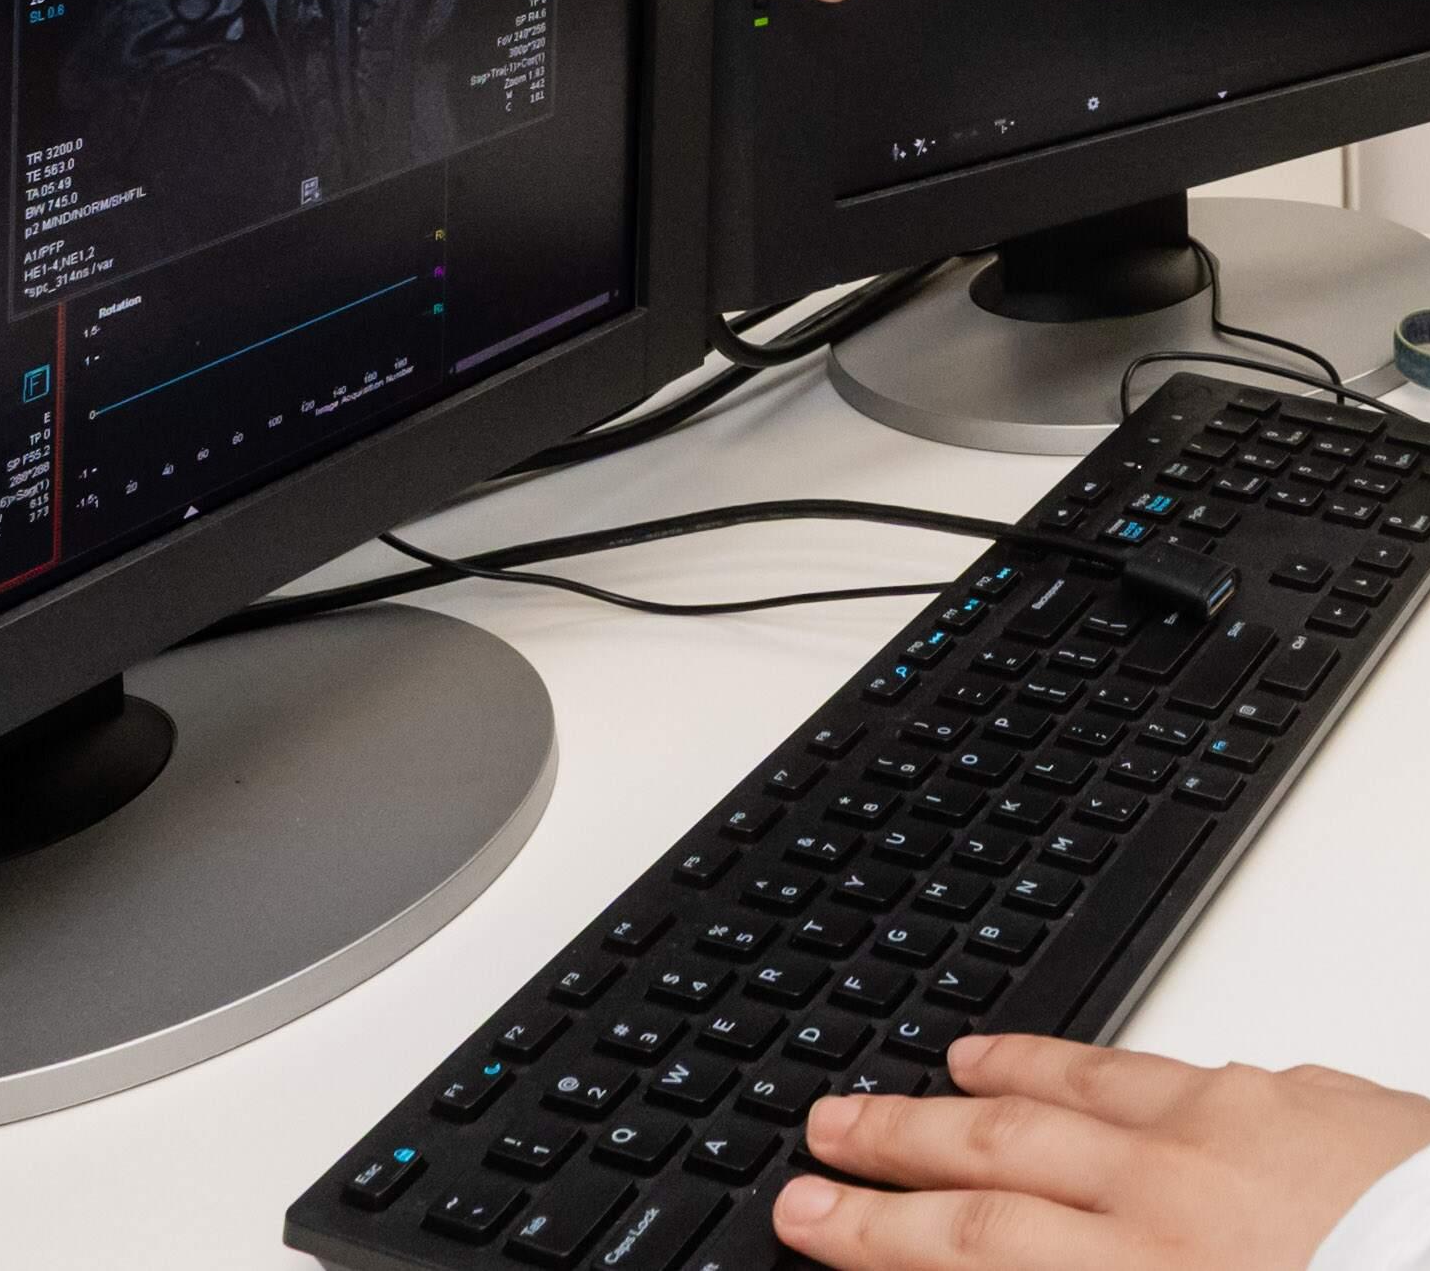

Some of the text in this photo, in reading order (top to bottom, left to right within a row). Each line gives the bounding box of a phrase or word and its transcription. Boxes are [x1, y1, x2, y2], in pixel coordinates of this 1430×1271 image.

[26, 138, 83, 165] TR 3200.0
[26, 158, 74, 184] TE 563.0
[41, 176, 72, 197] 05:49
[25, 192, 77, 220] BW 745.0
[99, 295, 142, 320] Rotation
[684, 856, 701, 869] F5
[614, 921, 632, 936] F4
[802, 921, 824, 935] T
[887, 929, 907, 942] G
[561, 971, 580, 986] F3
[759, 968, 783, 983] R
[844, 976, 864, 991] F
[505, 1025, 524, 1040] F2
[712, 1018, 735, 1033] E
[899, 1023, 920, 1036] C
[798, 1027, 820, 1042] D
[662, 1064, 690, 1085] W
[445, 1082, 465, 1099] F1
[753, 1080, 774, 1095] S
[852, 1075, 878, 1092] X
[610, 1127, 635, 1143] Q
[706, 1138, 727, 1155] A
[355, 1162, 383, 1185] Esc
[520, 1215, 545, 1238] Tab
[604, 1207, 660, 1266] Caps Lock
